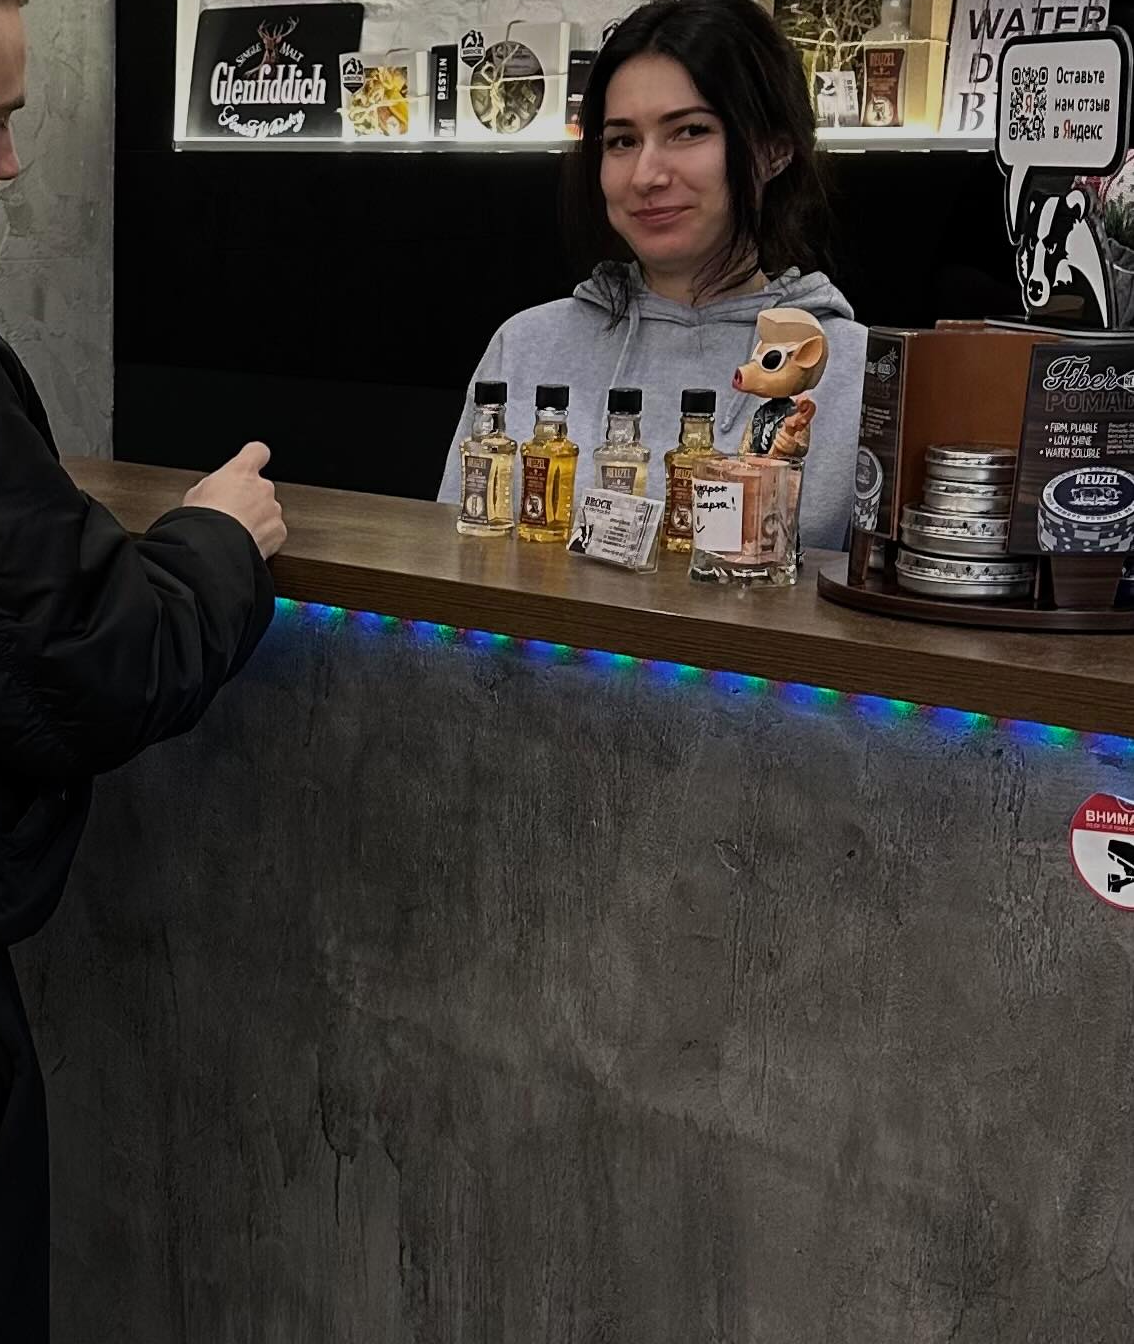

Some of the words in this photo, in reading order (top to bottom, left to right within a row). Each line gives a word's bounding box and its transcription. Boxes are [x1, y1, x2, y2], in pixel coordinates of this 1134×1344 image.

[969, 7, 1106, 39] WATER
[236, 42, 262, 67] SINGLE
[279, 42, 304, 62] MALT
[1056, 67, 1105, 84] Оставьте
[210, 61, 326, 106] Glenfiddich
[1054, 99, 1075, 112] нам
[1077, 98, 1110, 112] отзыв
[1053, 126, 1060, 139] в
[1063, 120, 1103, 143] Яндекс
[1042, 355, 1117, 390] Fiber
[1071, 423, 1098, 433] PLIABLE
[1053, 436, 1070, 445] LOW
[1072, 436, 1092, 446] SHINE
[1046, 448, 1070, 458] WATER
[1071, 448, 1101, 459] SOLUBLE
[1075, 474, 1120, 485] REUZEL
[585, 496, 613, 510] BROCK
